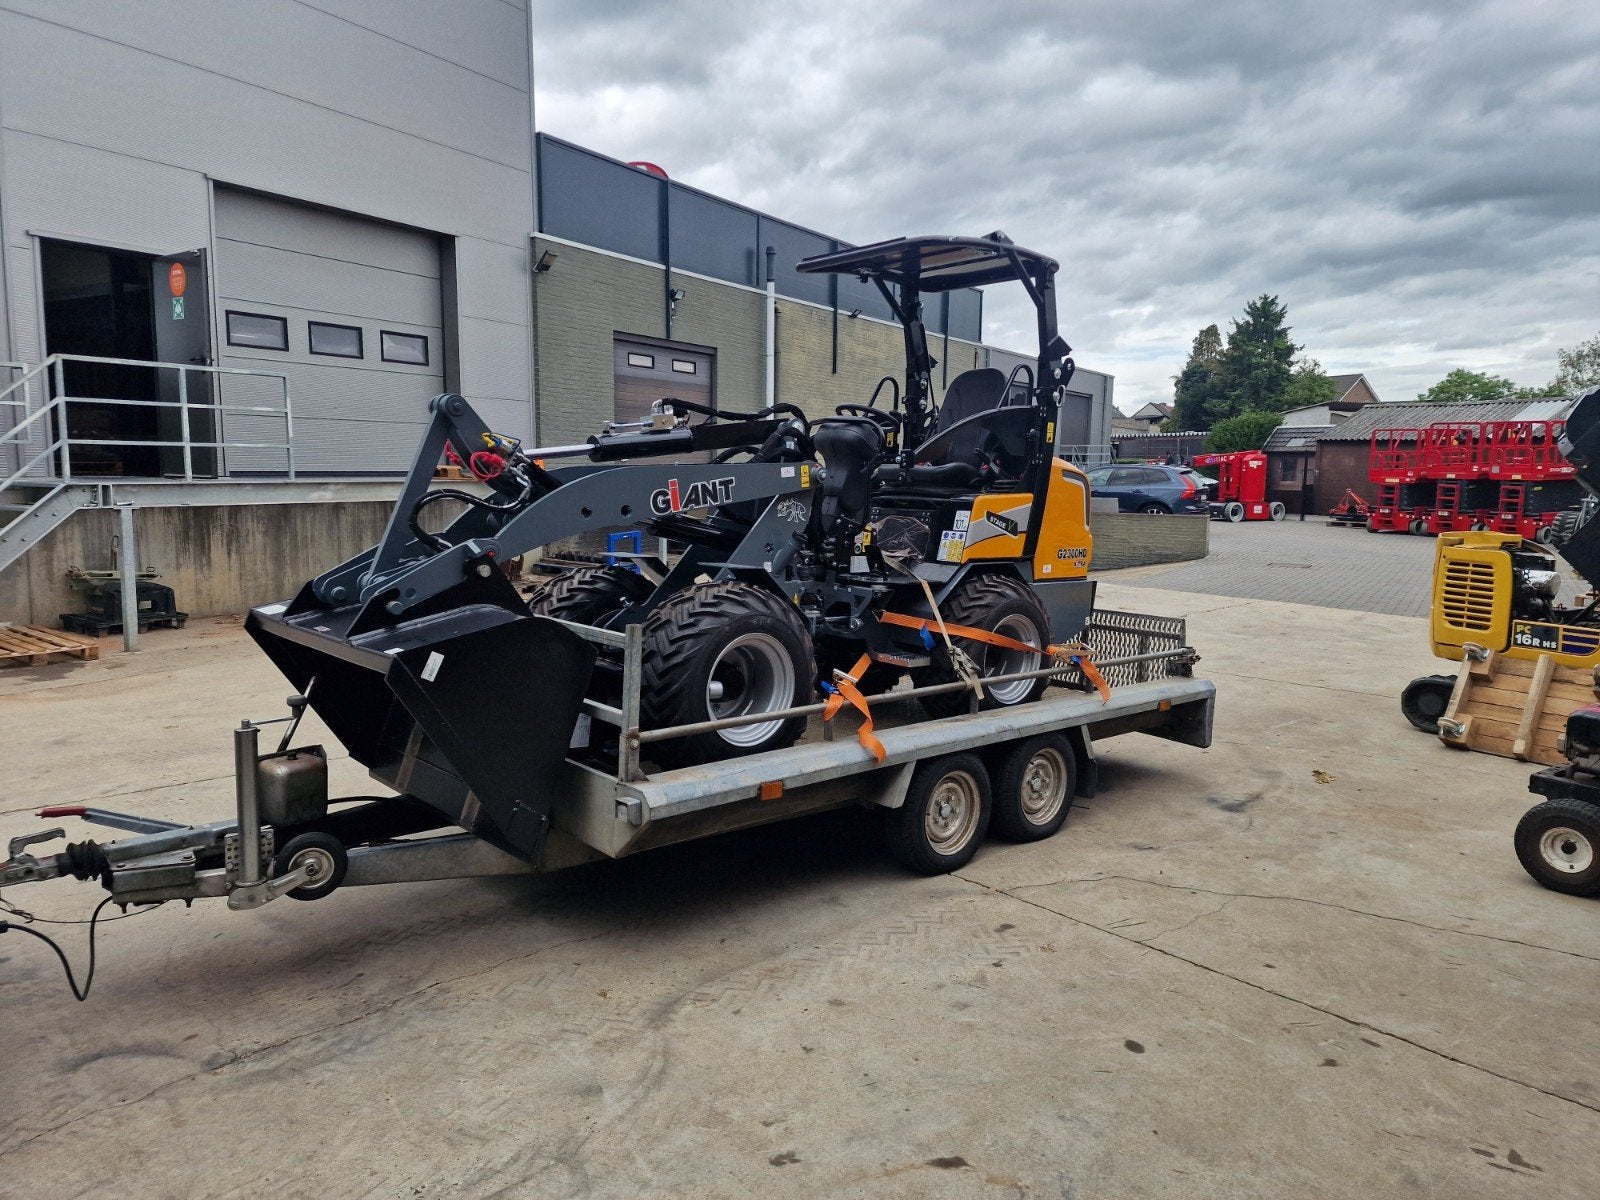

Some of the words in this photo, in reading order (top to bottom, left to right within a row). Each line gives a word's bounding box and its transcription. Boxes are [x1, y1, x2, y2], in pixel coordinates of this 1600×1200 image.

[990, 516, 1007, 529] STAGE
[1516, 625, 1532, 634] PC
[1542, 641, 1557, 649] HS
